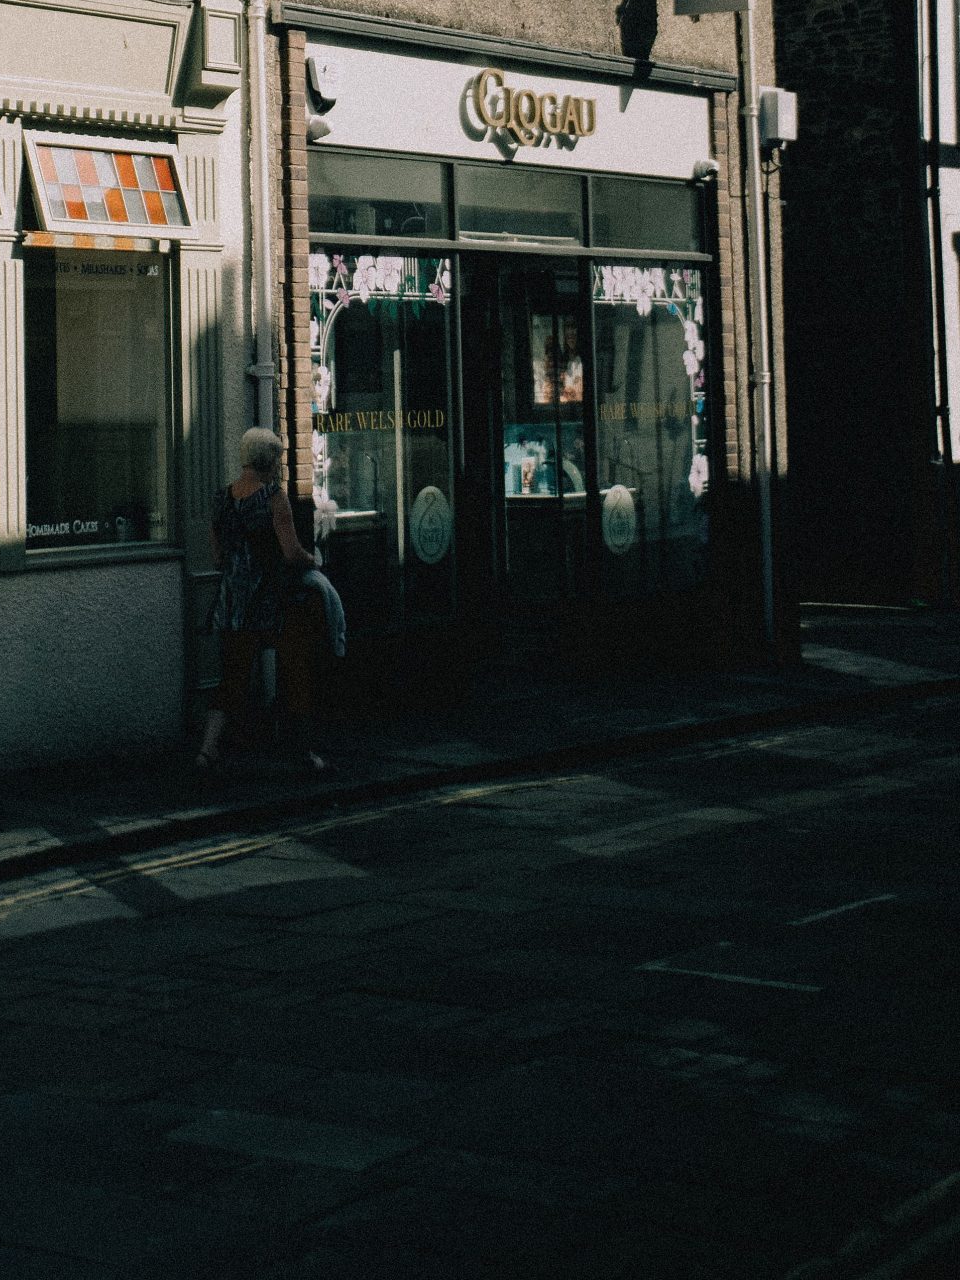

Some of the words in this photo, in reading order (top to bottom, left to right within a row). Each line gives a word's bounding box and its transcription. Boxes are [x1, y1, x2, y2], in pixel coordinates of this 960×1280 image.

[473, 67, 597, 147] CLOGAU
[316, 412, 352, 433] RARE
[407, 409, 445, 429] GOLD
[26, 522, 70, 538] HOMEMADE
[73, 519, 99, 534] CAKES
